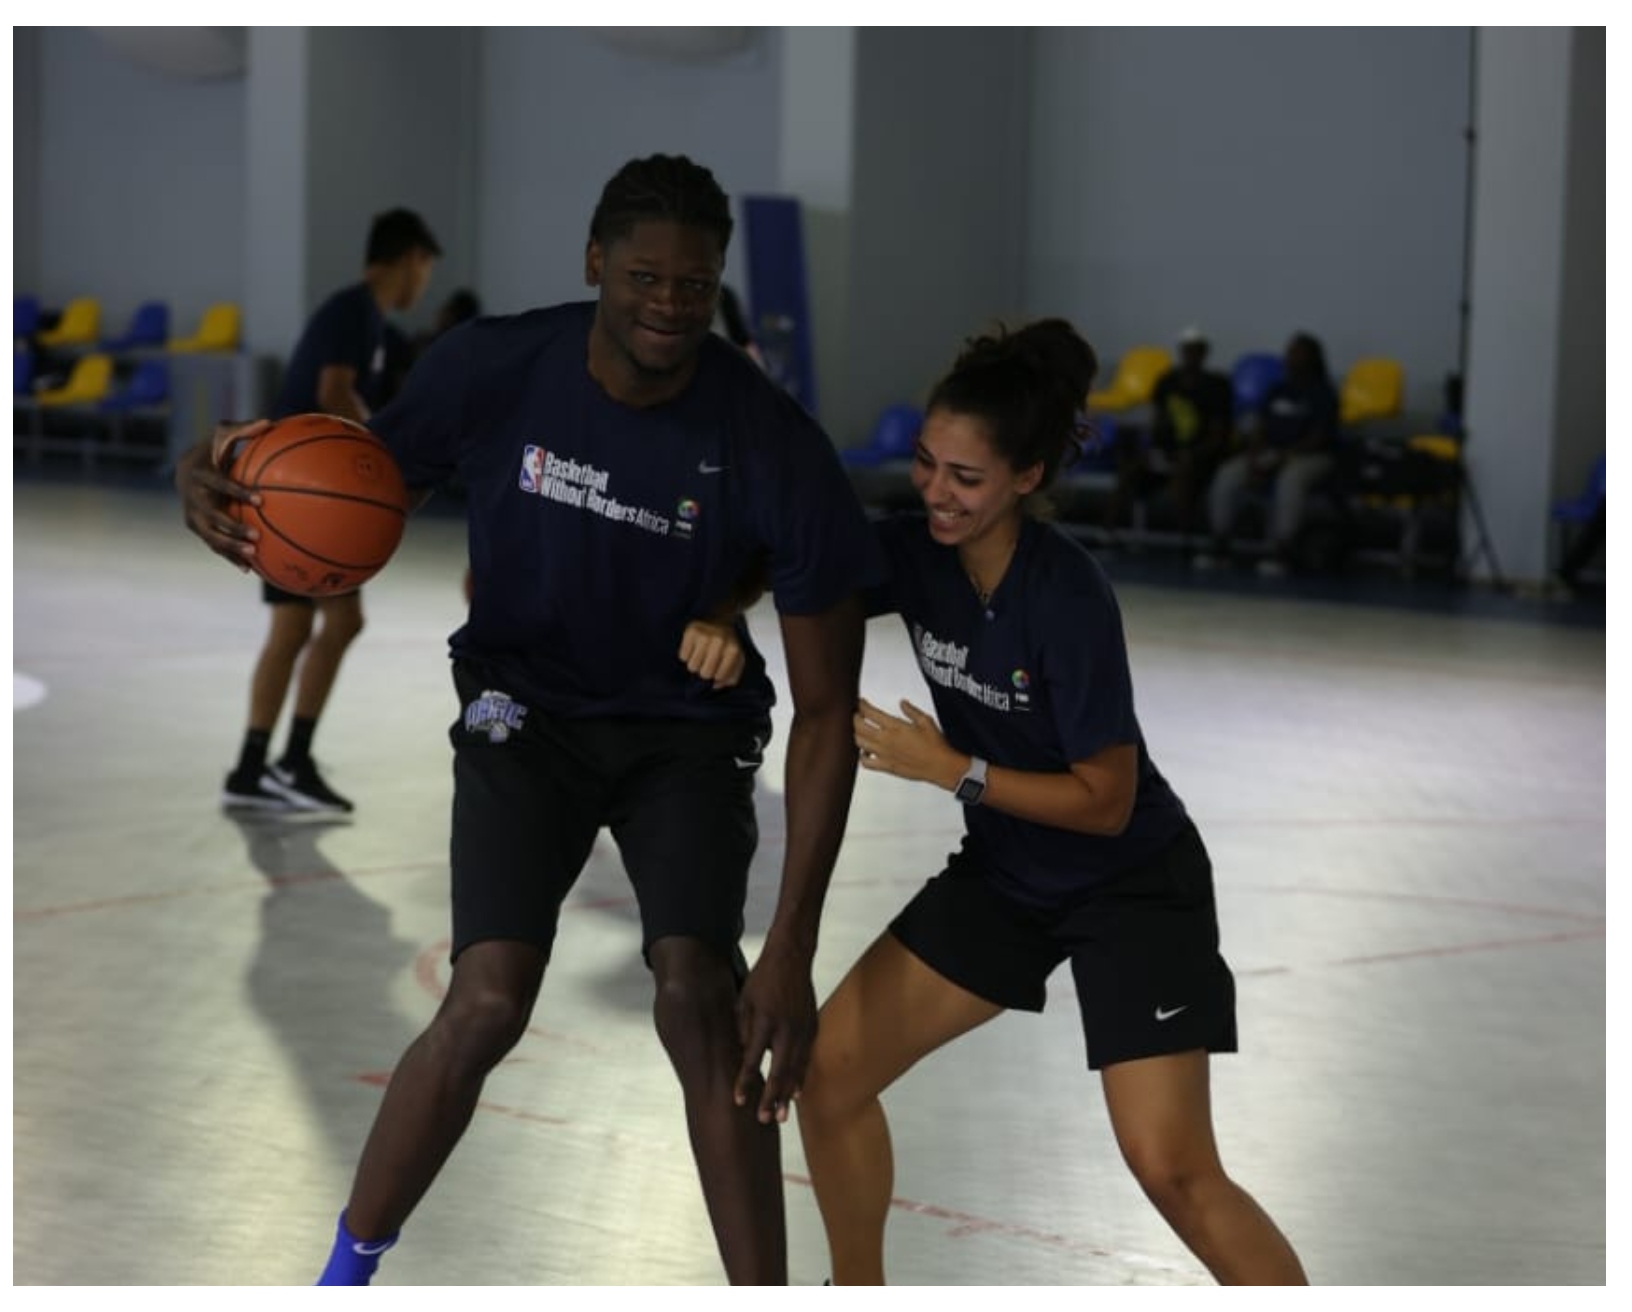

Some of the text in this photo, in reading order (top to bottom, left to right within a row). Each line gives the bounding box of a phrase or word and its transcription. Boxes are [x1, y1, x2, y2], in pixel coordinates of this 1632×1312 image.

[543, 451, 609, 493] Basketball
[540, 475, 670, 535] Without Borders Africa
